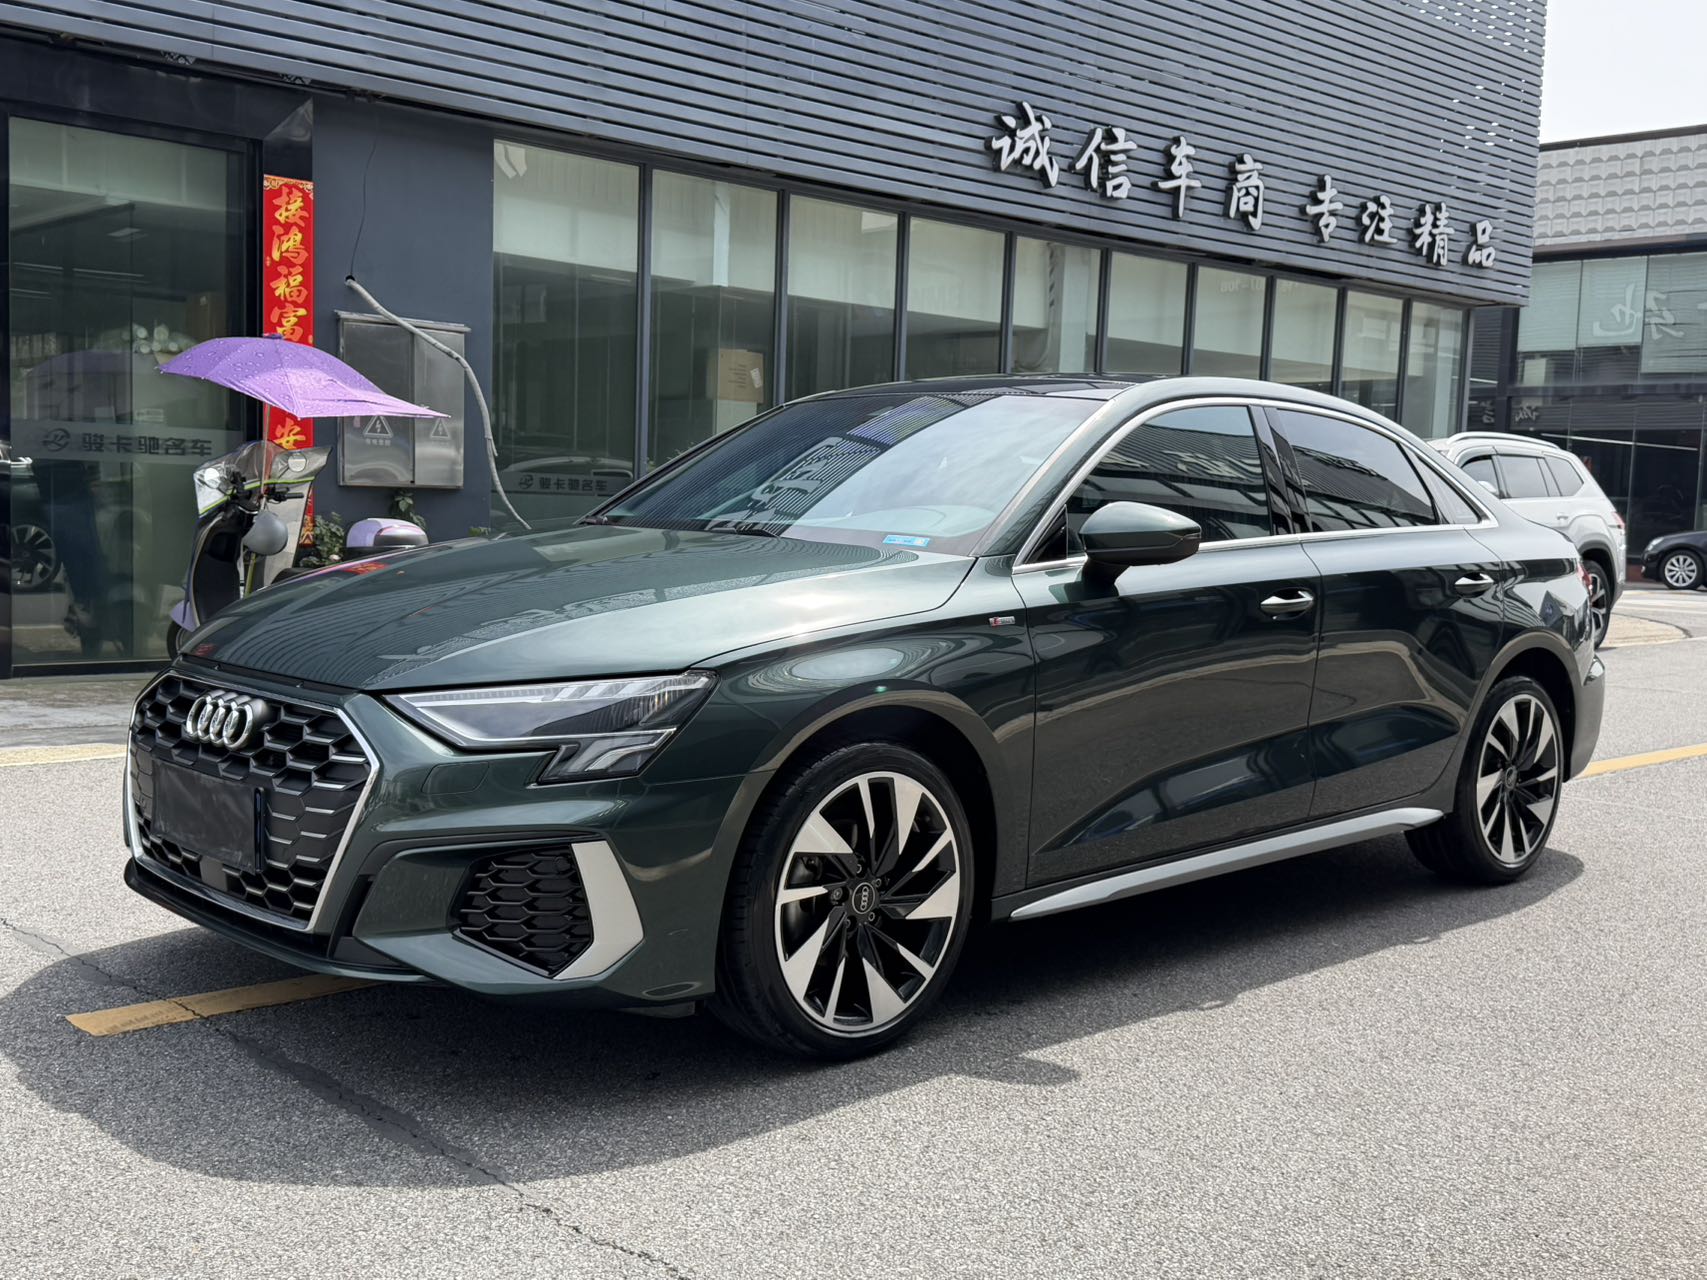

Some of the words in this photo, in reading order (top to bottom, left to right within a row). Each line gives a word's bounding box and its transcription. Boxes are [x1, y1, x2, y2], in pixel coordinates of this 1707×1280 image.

[988, 101, 1264, 231] 诚信车商
[1303, 174, 1497, 268] 专注精品
[81, 433, 212, 457] 骏卡驰名车
